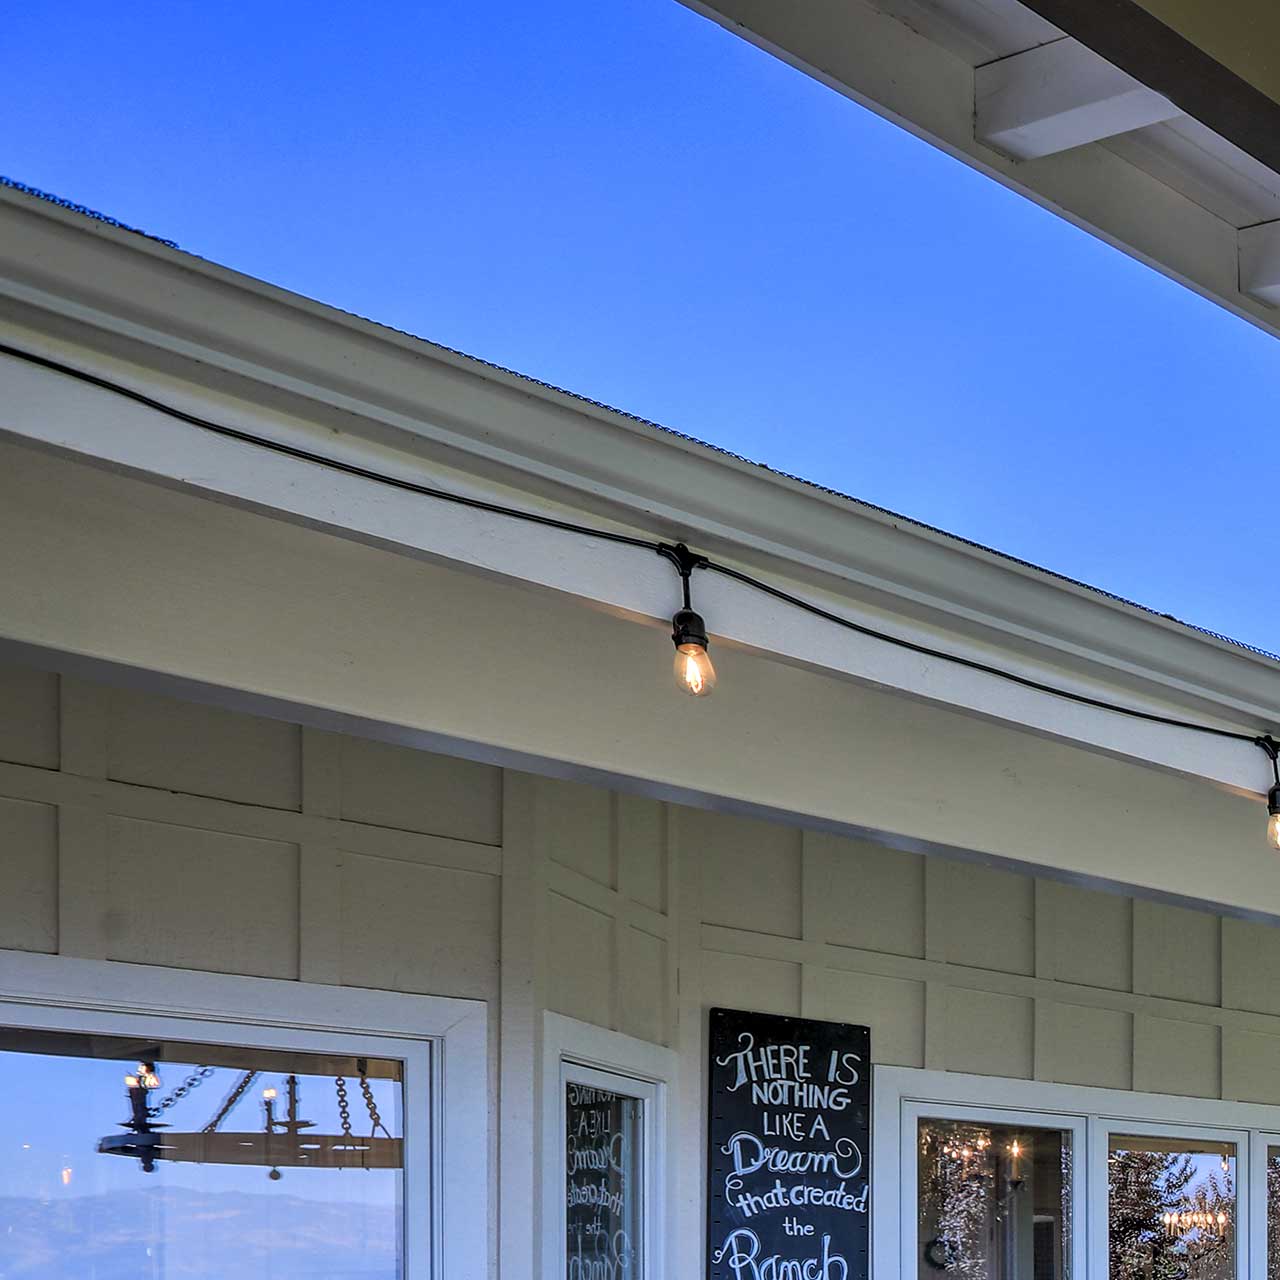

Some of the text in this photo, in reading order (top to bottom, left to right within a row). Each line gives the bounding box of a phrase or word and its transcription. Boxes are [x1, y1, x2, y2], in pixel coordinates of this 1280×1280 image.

[716, 1032, 861, 1092] THERE IS
[752, 1079, 852, 1111] NOTHING
[763, 1111, 831, 1142] LIKE A
[721, 1131, 862, 1178] Dream
[726, 1172, 868, 1217] that created
[782, 1217, 815, 1236] the
